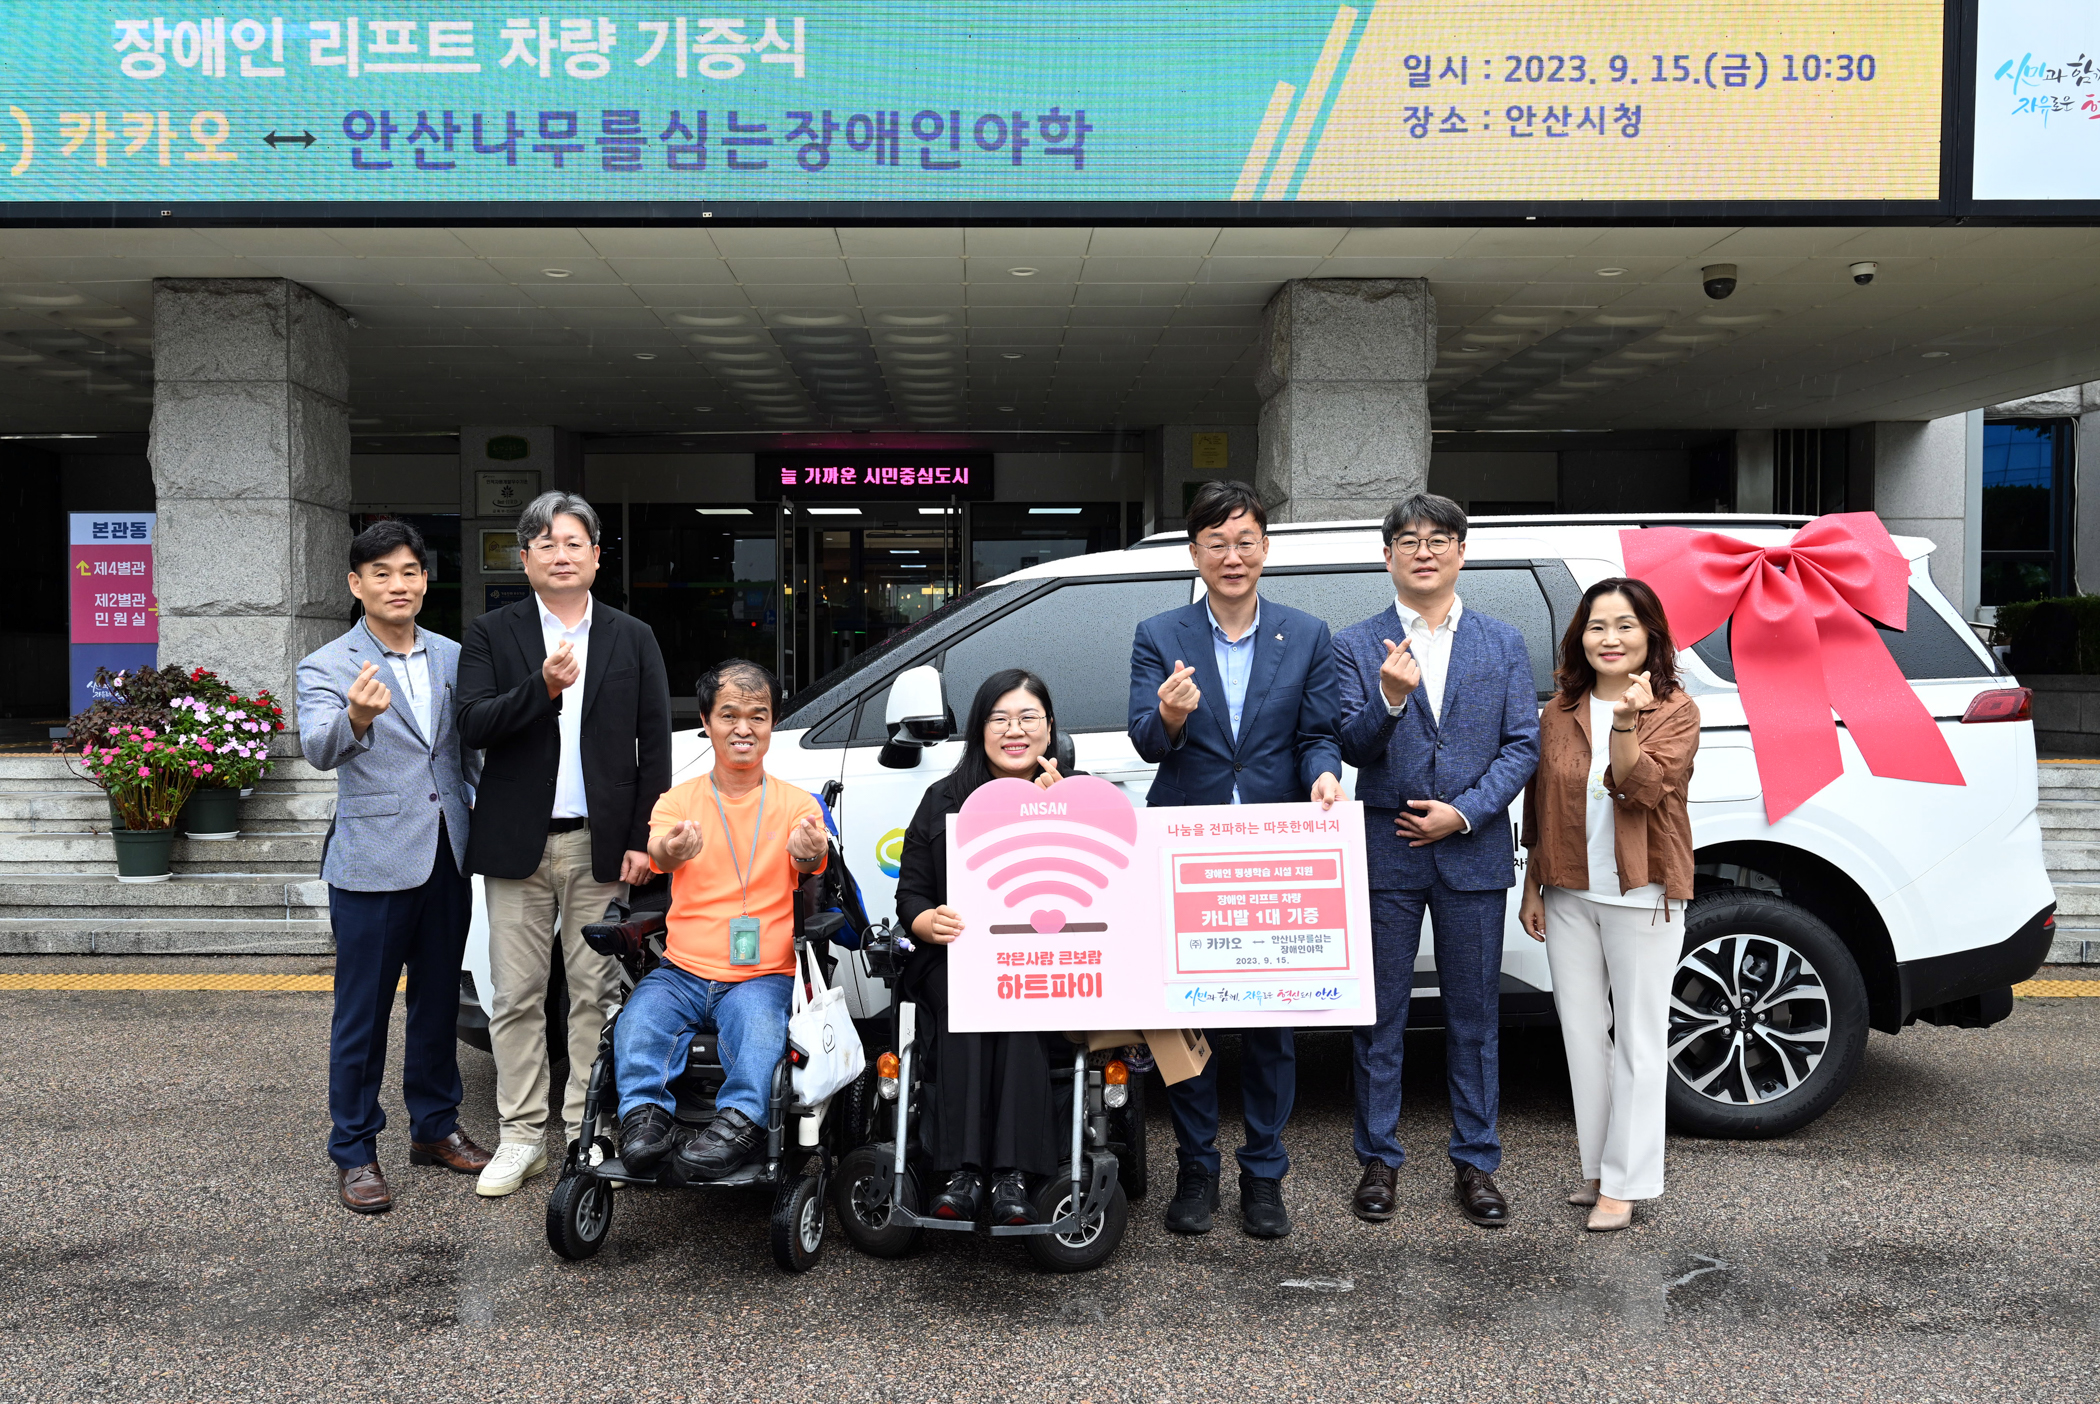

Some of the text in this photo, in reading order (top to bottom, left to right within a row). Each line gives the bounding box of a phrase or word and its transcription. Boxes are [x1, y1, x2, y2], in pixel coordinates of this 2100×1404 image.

[112, 16, 806, 79] 장애인 리프트 차량 기증식
[1402, 53, 1469, 87] 일시
[1503, 54, 1597, 84] 2023.
[1608, 54, 1640, 84] 9.
[1780, 53, 1876, 83] 10:30
[1994, 52, 2100, 95] 시민과 함
[1402, 104, 1470, 139] 장소
[1504, 103, 1643, 139] 안산시청
[2011, 95, 2076, 129] 자유로운
[59, 110, 239, 167] 카카오
[342, 106, 1094, 173] 안산나무를심는장애인야학
[780, 466, 969, 486] 늘 가까운 시민중심도시
[92, 521, 147, 539] 본관동
[93, 561, 146, 576] 제4별관
[94, 593, 146, 607] 제2별관
[1019, 801, 1068, 817] ANSAN
[1167, 819, 1340, 837] 나눔을 전파하는 따뜻한에너지
[1204, 866, 1314, 879] 장애인 평생학습 시설 지원
[1217, 892, 1302, 906] 장애인 리프트 차량
[1201, 907, 1319, 927] 카니발 1대 기증
[1206, 937, 1243, 950] 카카오
[1271, 934, 1332, 945] 안산나무를심는
[1280, 944, 1324, 955] 장애인야학
[1058, 949, 1103, 966] 큰보람
[1235, 956, 1290, 965] 2023. 9. 15.
[996, 972, 1103, 1000] 하트파이
[1184, 987, 1217, 1006] 시민과
[1242, 989, 1274, 1007] 자유로운
[1315, 987, 1343, 1001] 안산
